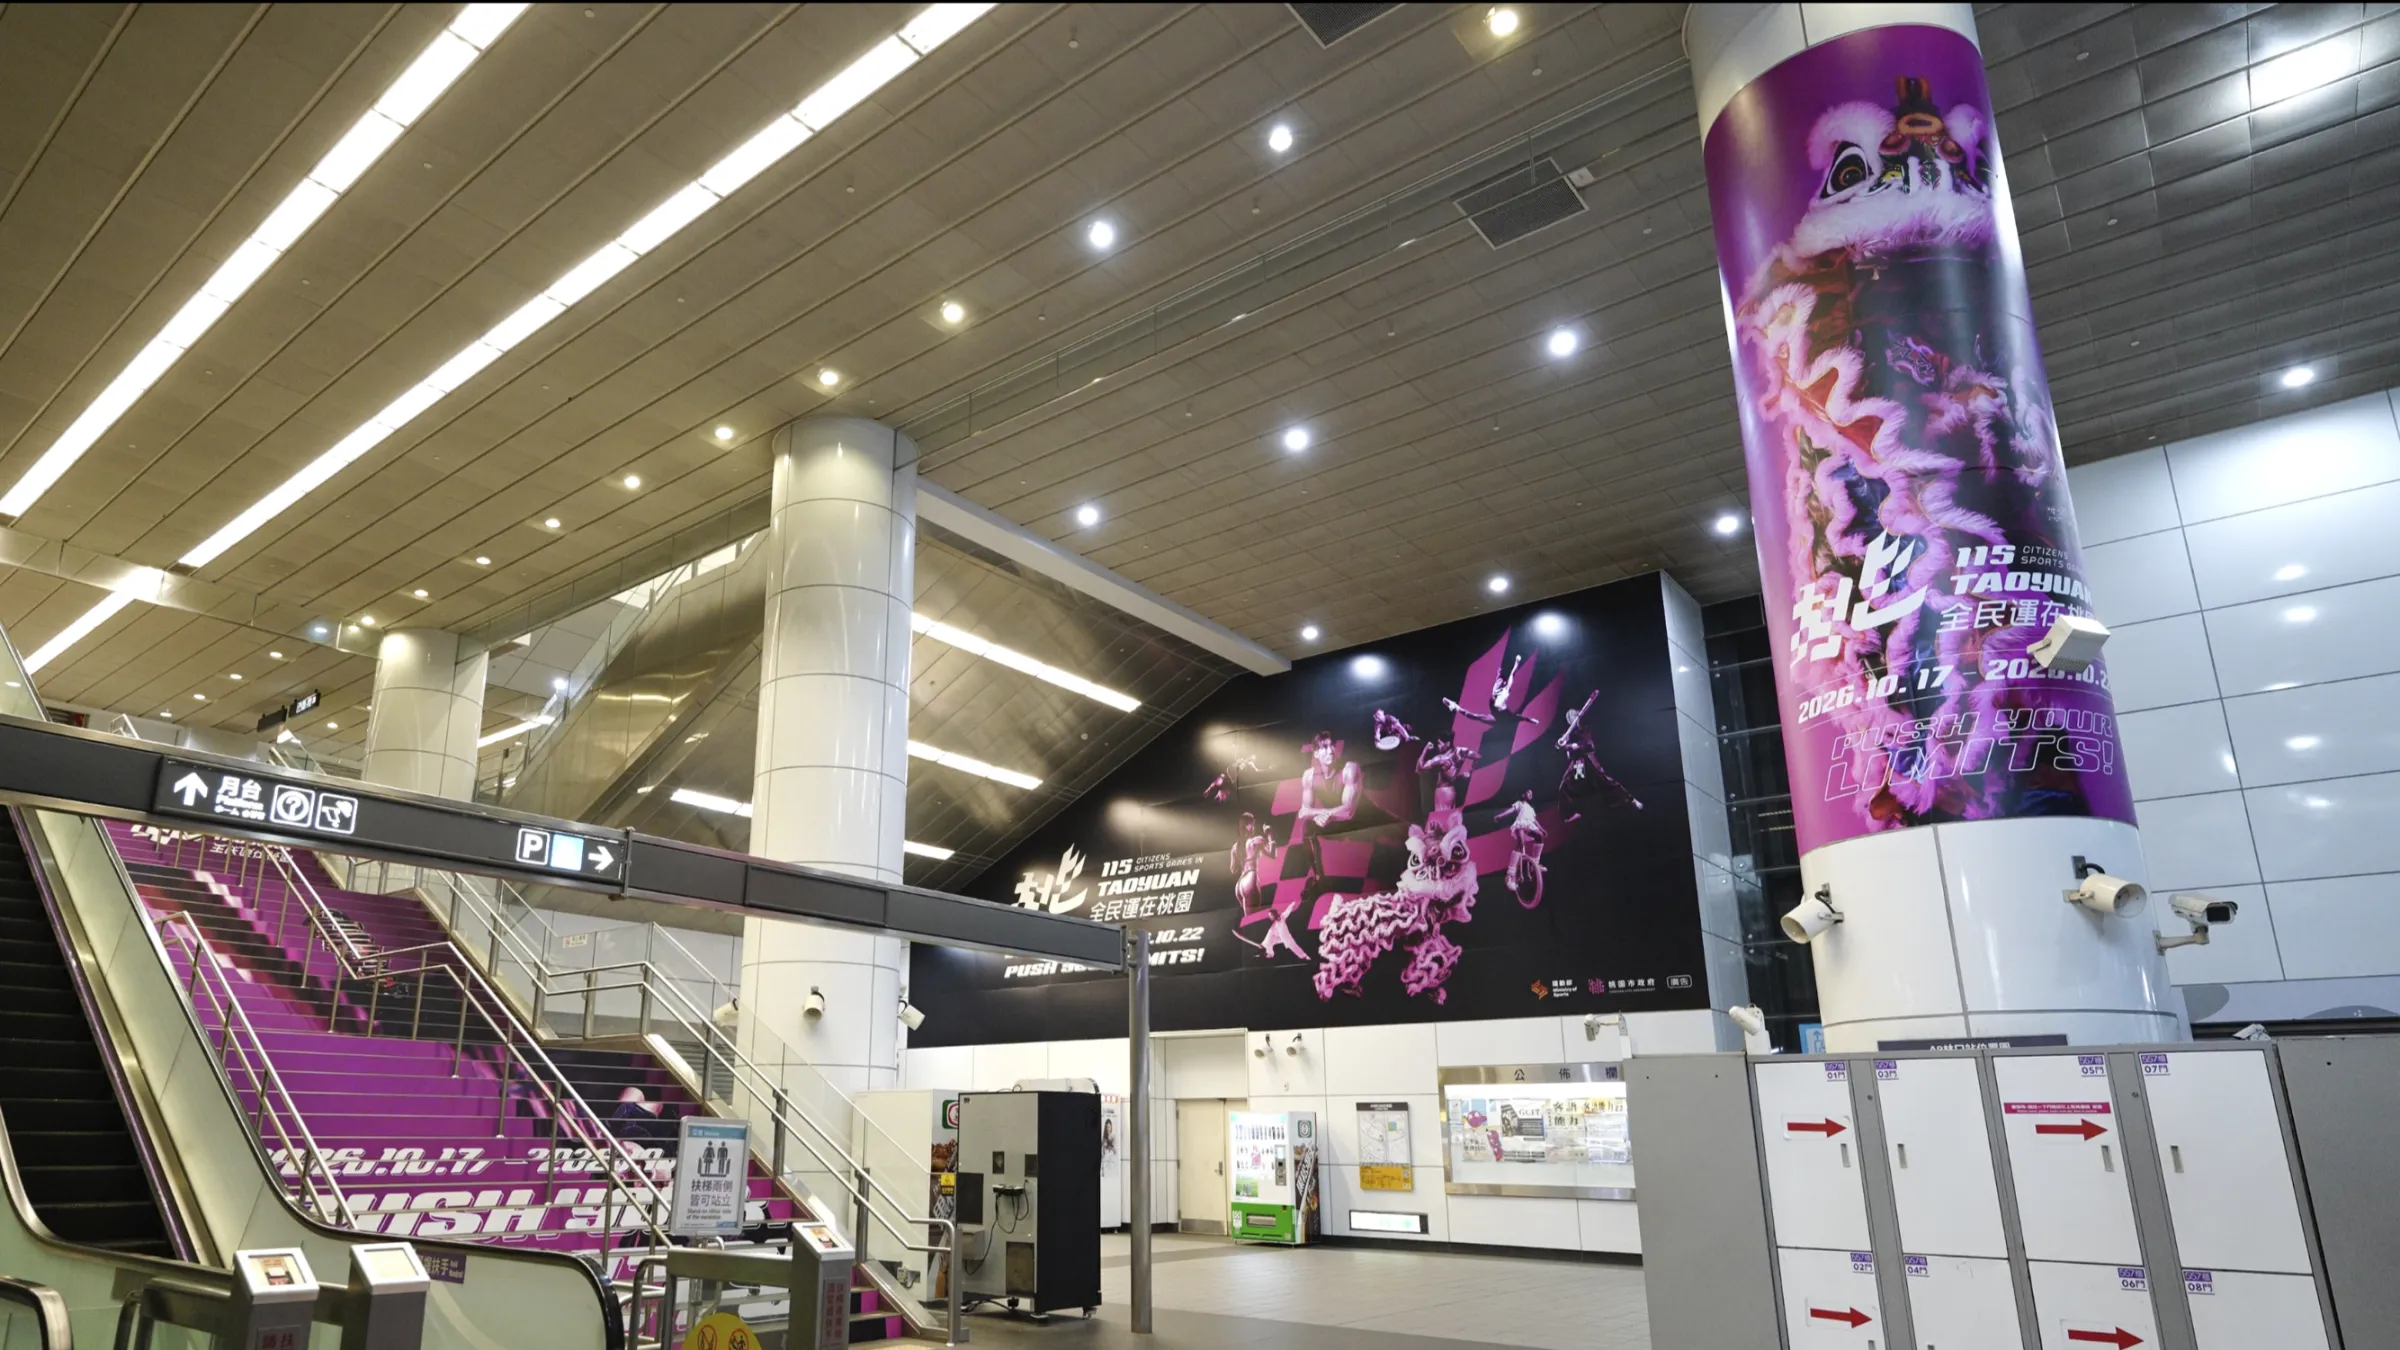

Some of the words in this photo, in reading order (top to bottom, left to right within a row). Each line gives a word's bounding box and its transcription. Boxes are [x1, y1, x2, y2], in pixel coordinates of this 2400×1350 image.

[1956, 545, 2016, 568] 115
[2022, 546, 2069, 560] CITIZENS
[2021, 556, 2064, 569] SPORTS
[1950, 571, 2093, 606] TAOYUAN
[1831, 711, 1980, 760] PUSH
[1993, 707, 2113, 738] YOUR
[1824, 736, 2114, 802] LIMITS!
[217, 775, 262, 801] 月台
[1134, 862, 1163, 873] SPORTS
[1166, 858, 1192, 868] GAMES
[1194, 856, 1204, 864] IN
[1136, 853, 1171, 864] CITIZENS
[1101, 859, 1133, 877] 115
[1098, 869, 1200, 897] TAOYUAN
[1089, 890, 1195, 922] 全民運在桃園
[1004, 962, 1057, 979] PUSH
[1148, 948, 1205, 967] MITS!
[1608, 978, 1655, 989] 桃園市政府
[1877, 1070, 1897, 1078] 03門
[2081, 1066, 2104, 1074] 05門
[2144, 1065, 2168, 1073] 07門
[420, 1255, 449, 1277] 握扶手
[1853, 1263, 1872, 1271] 02門
[1907, 1266, 1927, 1274] 04門
[2121, 1280, 2145, 1289] 06門
[2187, 1283, 2212, 1292] 08門
